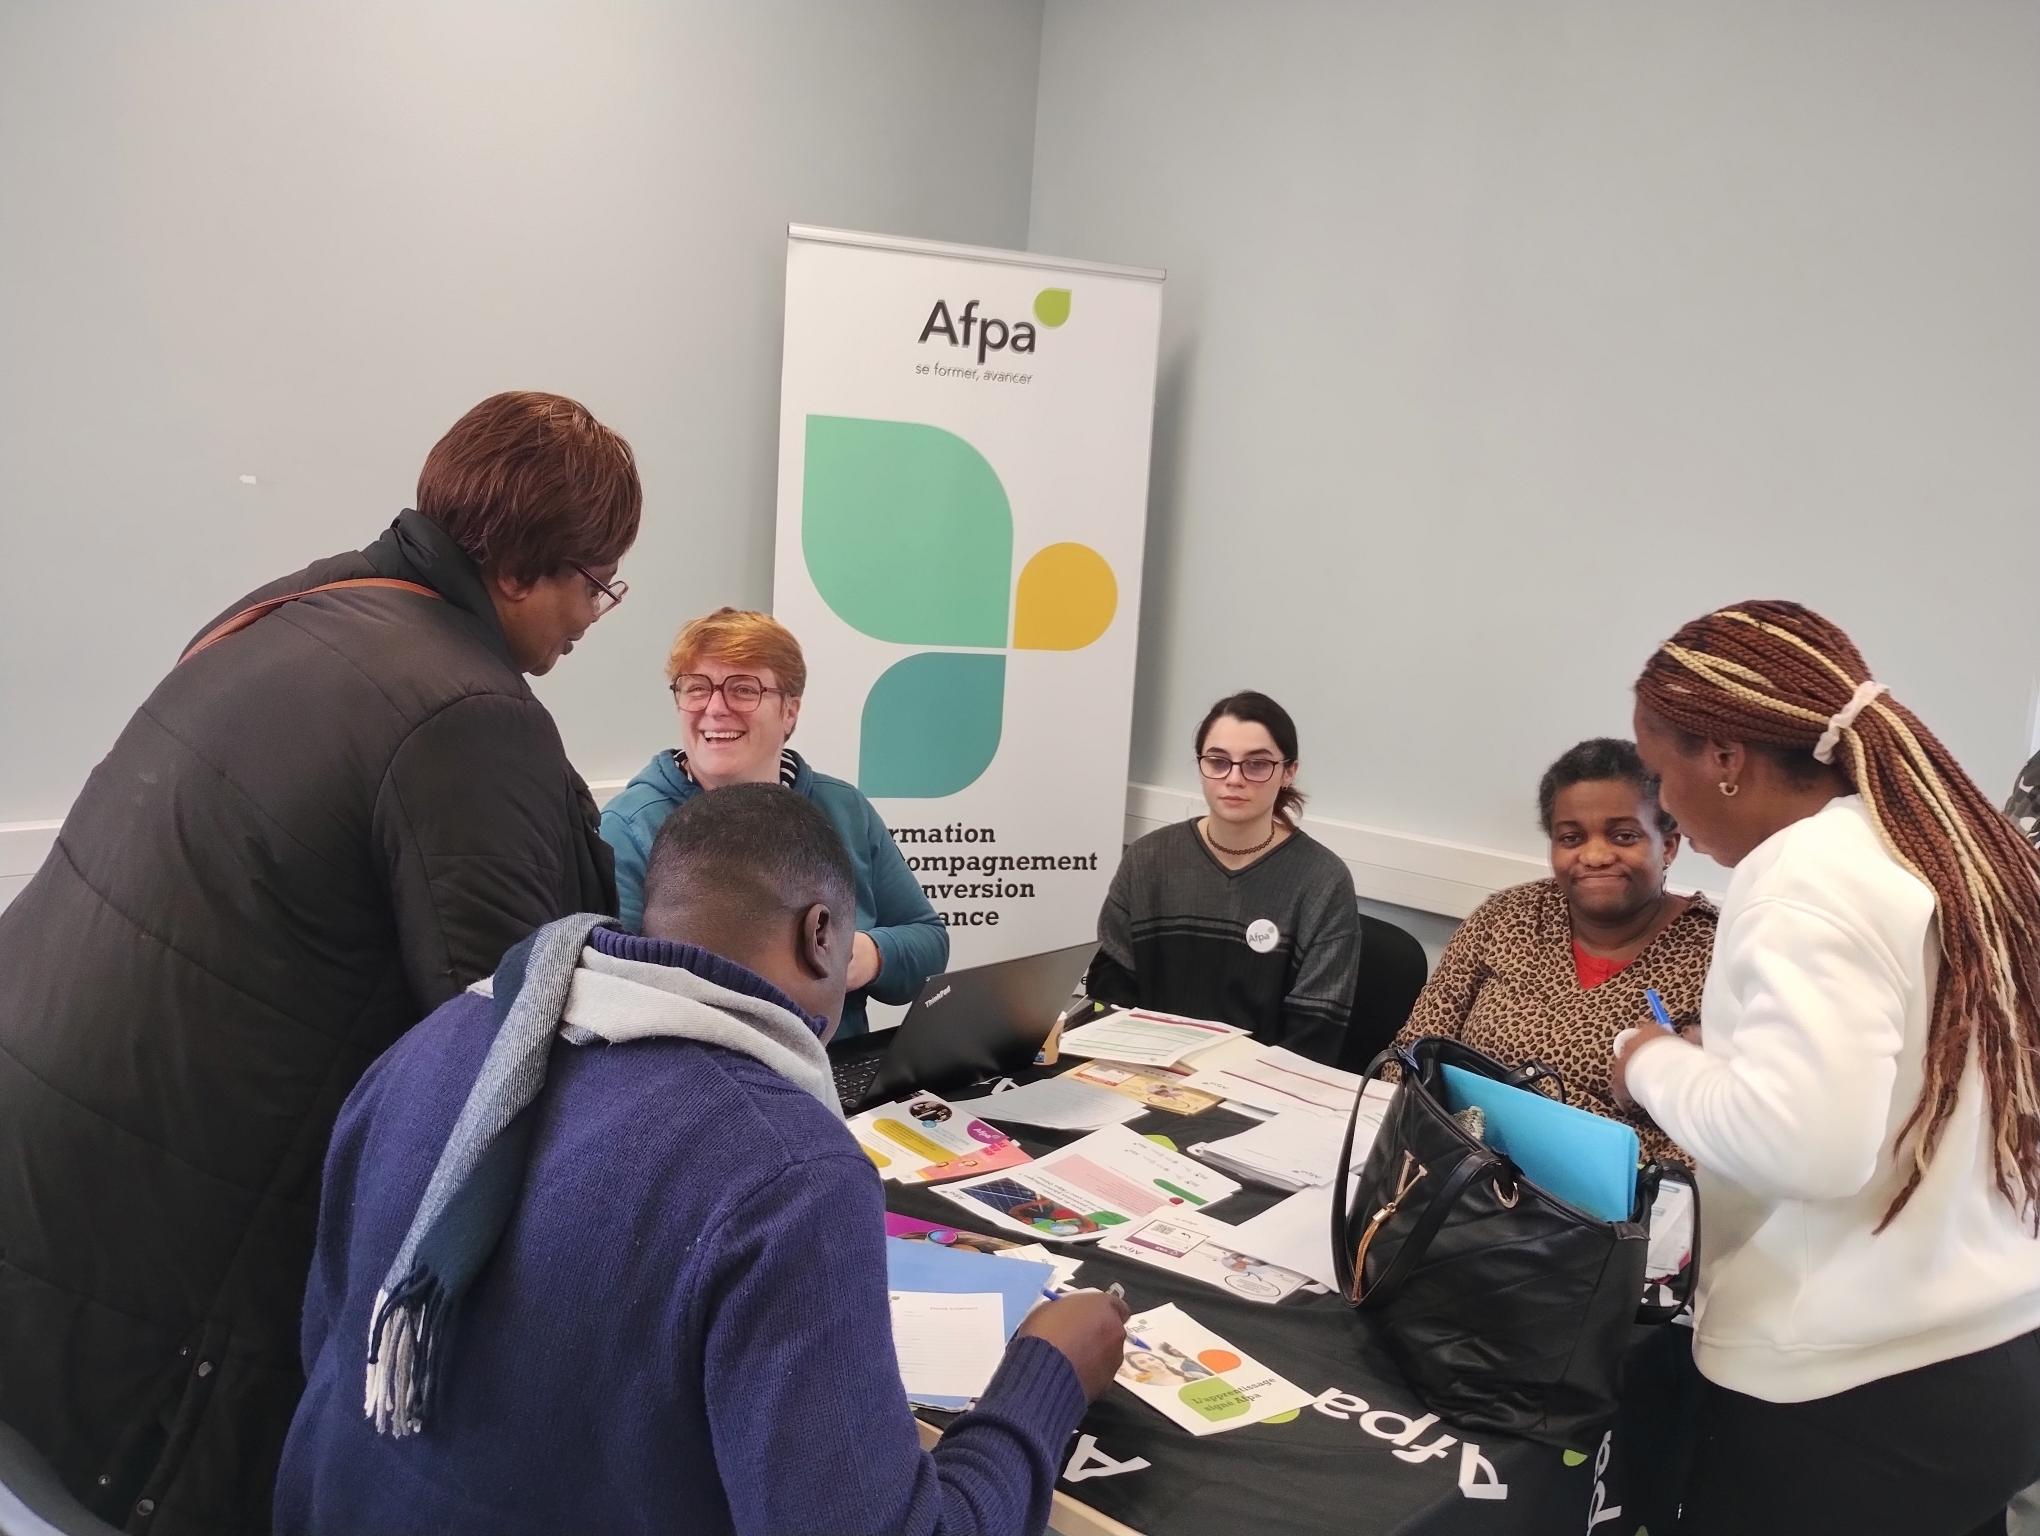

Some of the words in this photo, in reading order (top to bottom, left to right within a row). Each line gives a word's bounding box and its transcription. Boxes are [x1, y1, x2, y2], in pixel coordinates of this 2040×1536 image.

[917, 298, 1037, 366] Afpa
[915, 363, 930, 375] se
[934, 360, 980, 381] former,
[983, 369, 1033, 385] avancer
[903, 852, 1098, 877] ompagnement
[1249, 932, 1270, 944] Afpa
[1204, 1400, 1234, 1412] signe
[1233, 1392, 1262, 1405] Afpa
[1062, 1429, 1152, 1483] A
[1313, 1387, 1508, 1500] Afpa
